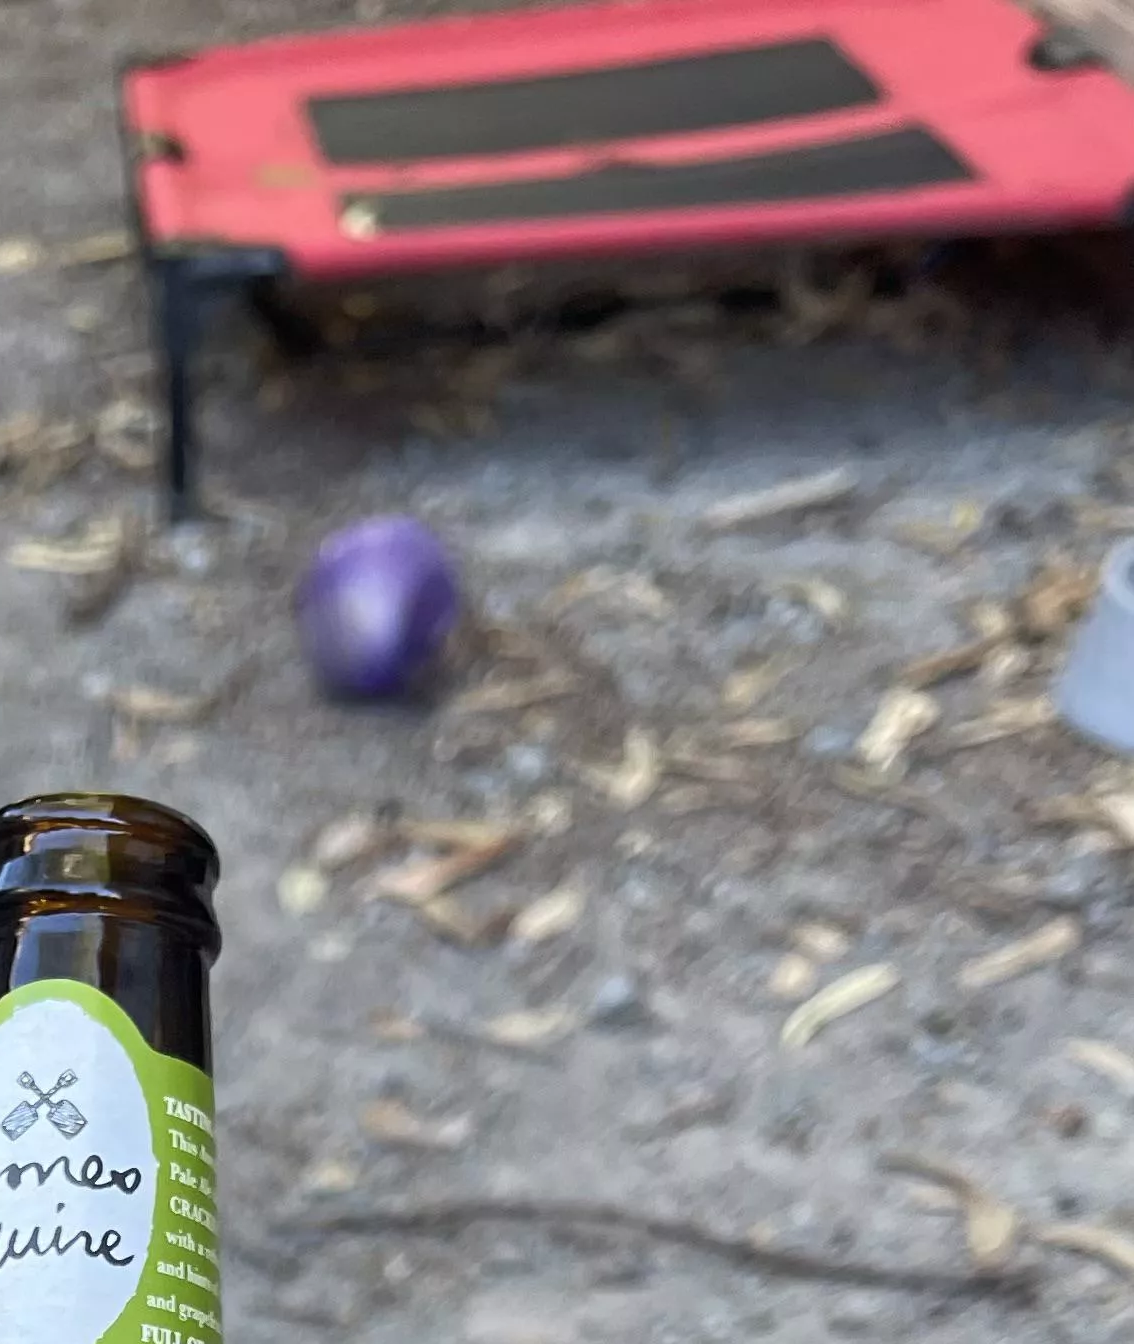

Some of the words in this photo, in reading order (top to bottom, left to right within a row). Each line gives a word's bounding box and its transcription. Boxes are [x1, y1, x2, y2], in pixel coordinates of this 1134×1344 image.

[168, 1129, 198, 1157] This
[170, 1162, 197, 1188] Pale
[166, 1229, 196, 1252] with
[156, 1260, 186, 1280] and
[146, 1294, 176, 1313] and
